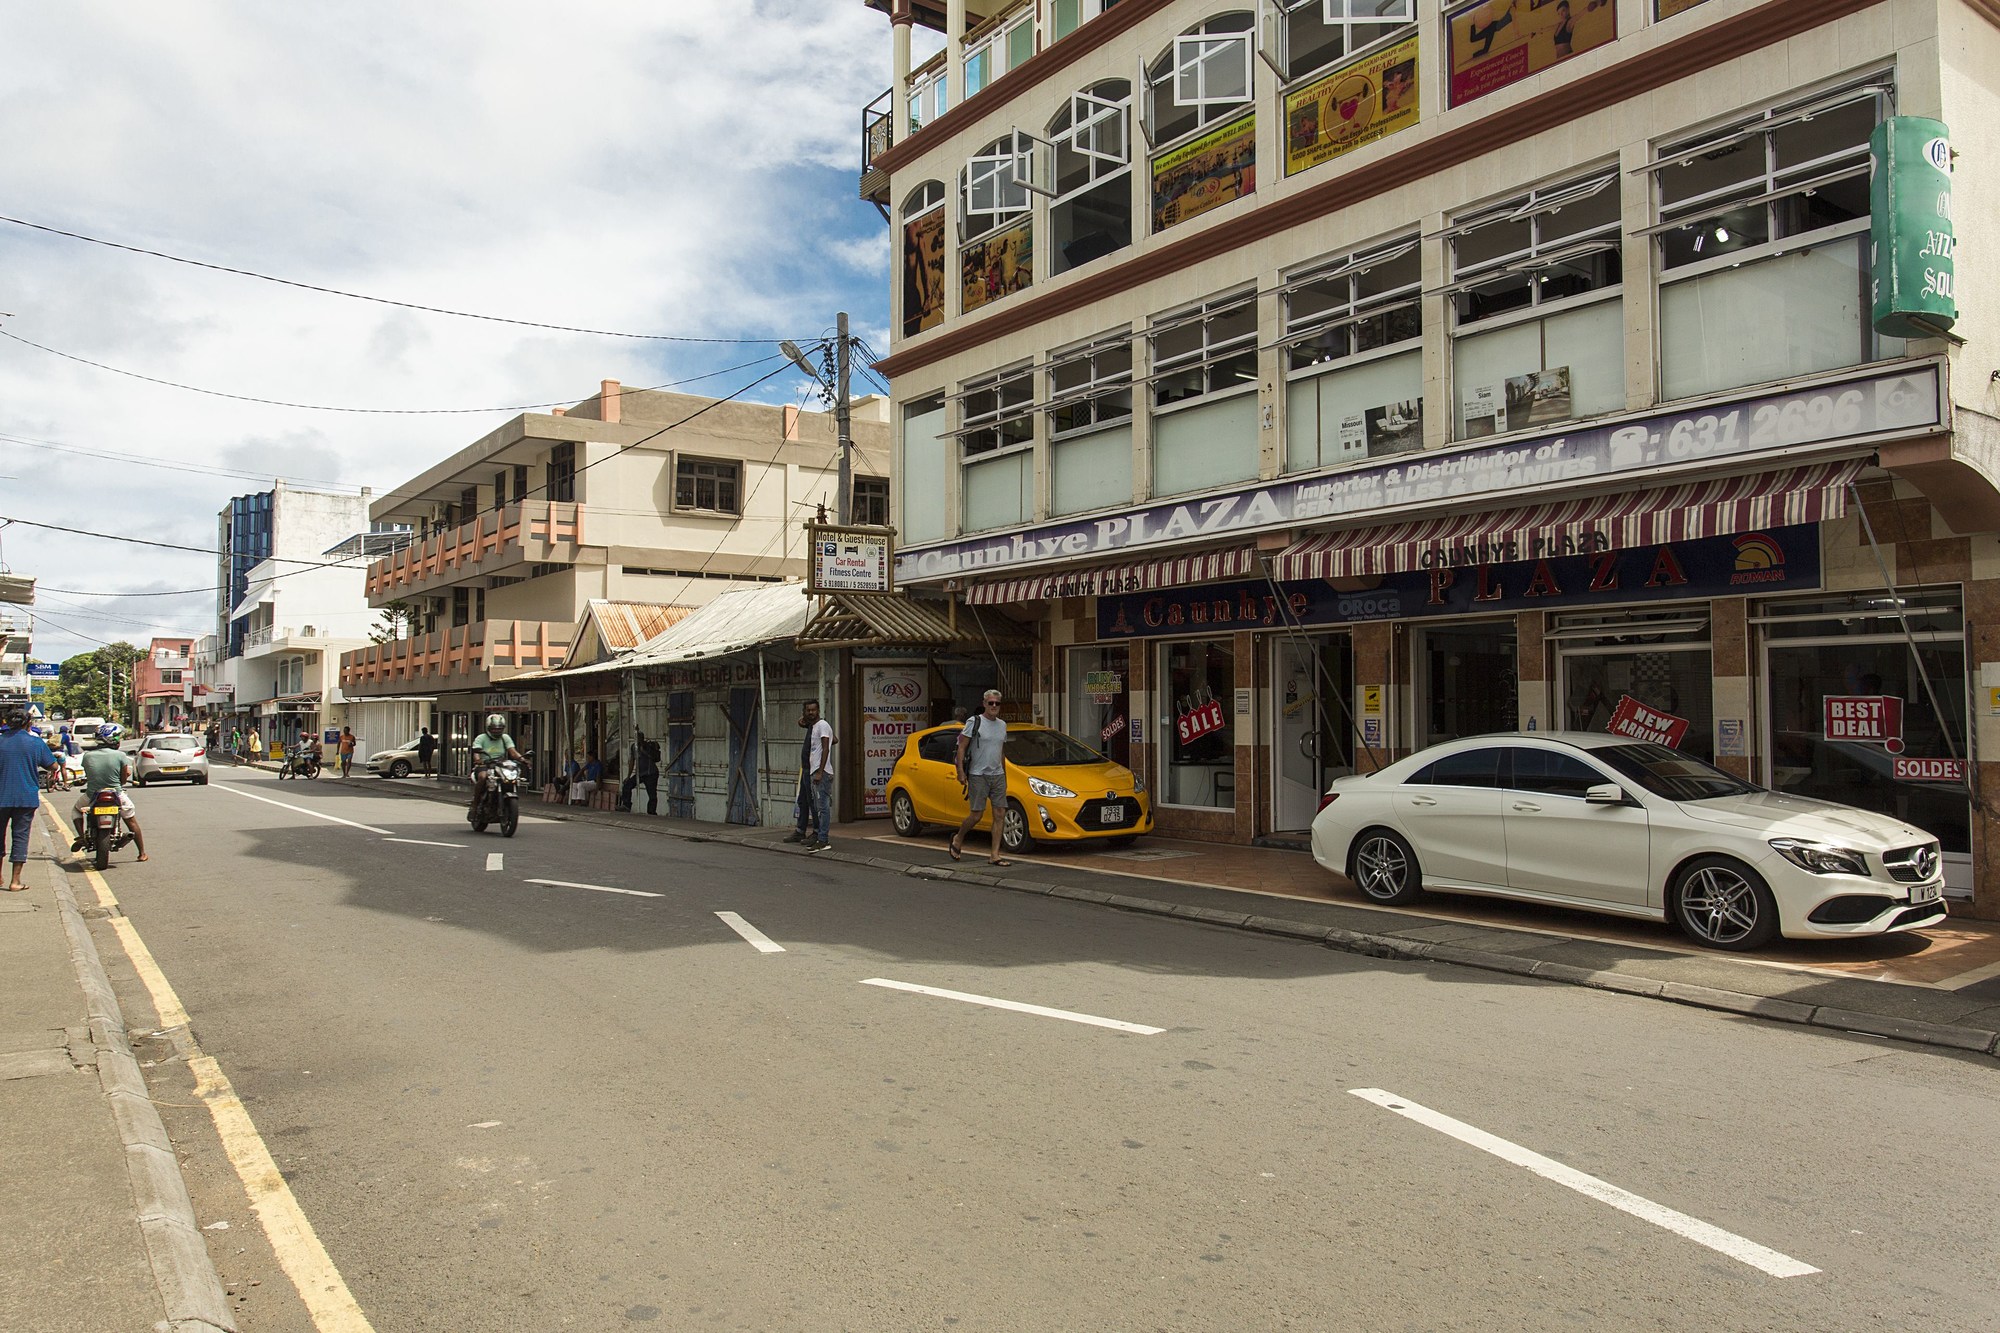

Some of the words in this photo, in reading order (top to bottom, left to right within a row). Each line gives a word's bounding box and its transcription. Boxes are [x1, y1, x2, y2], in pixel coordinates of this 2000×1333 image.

[1364, 57, 1380, 69] GOOD
[1379, 49, 1398, 62] SHAPE
[1369, 56, 1400, 76] HEART
[1296, 85, 1333, 108] HEALTHY
[1370, 108, 1412, 130] Professionalism
[1222, 128, 1238, 140] WELL
[1238, 121, 1254, 134] BEING
[1360, 128, 1384, 142] SUCCESS
[1342, 418, 1362, 428] Missouri
[1668, 410, 1741, 458] 631
[1749, 390, 1864, 445] 2696
[1297, 474, 1381, 502] Importer
[1384, 468, 1401, 488] &
[1406, 446, 1530, 483] Distributor
[1535, 438, 1566, 460] of
[1294, 490, 1384, 519] CERAMIC
[1386, 480, 1444, 508] TILES
[1447, 477, 1467, 496] &
[1472, 456, 1597, 492] GRANITES
[816, 531, 836, 542] Motel
[838, 533, 842, 542] &
[844, 533, 864, 544] Guest
[865, 534, 886, 546] House
[916, 531, 1088, 577] Caunhye
[1095, 491, 1286, 550] PLAZA
[1421, 541, 1519, 569] CAUNHYE
[1533, 531, 1609, 557] PLAZA
[836, 557, 846, 566] Car
[847, 558, 866, 567] Rental
[830, 568, 851, 577] Fitness
[852, 568, 872, 578] Centre
[1730, 570, 1786, 586] ROMAN
[1101, 576, 1140, 593] PLAZA
[1143, 589, 1308, 627] Caunhye
[1088, 672, 1114, 684] BUY
[1084, 683, 1121, 693] WHOLESALE
[1095, 694, 1112, 704] PRICE
[1634, 706, 1674, 732] NEW
[1832, 702, 1881, 720] BEST
[1102, 718, 1124, 740] SOLDES
[1180, 708, 1220, 738] SALE
[1618, 718, 1672, 746] ARRIVAL
[1832, 720, 1881, 738] DEAL
[867, 749, 887, 758] CAR
[1898, 760, 1965, 778] SOLDES
